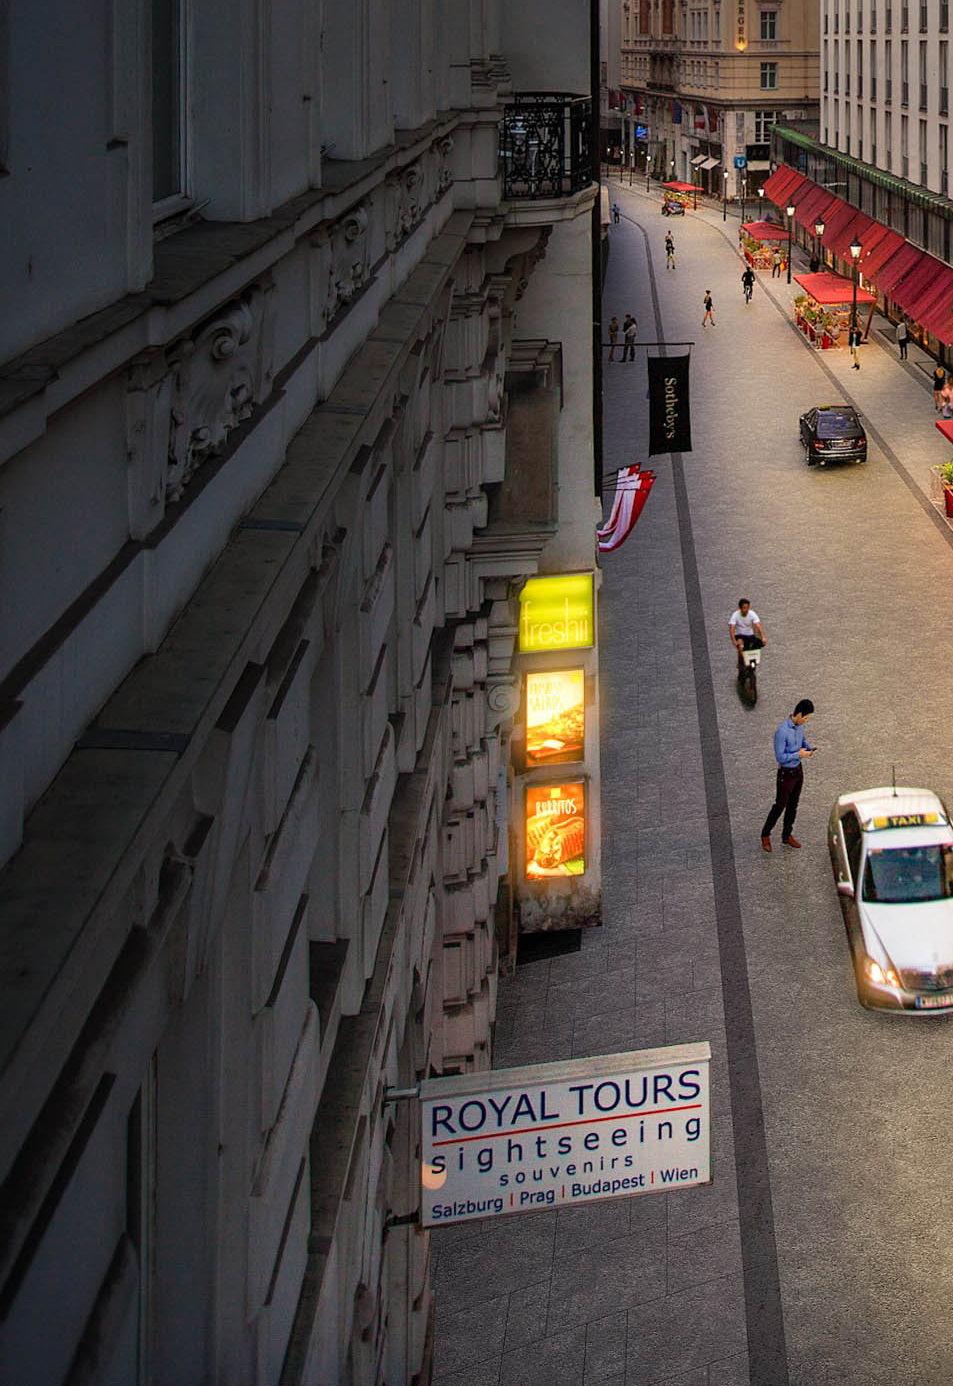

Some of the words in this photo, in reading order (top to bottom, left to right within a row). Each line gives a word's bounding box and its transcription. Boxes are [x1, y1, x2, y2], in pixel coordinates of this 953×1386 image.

[663, 377, 679, 439] Sotheby's
[522, 597, 589, 647] freshii
[891, 815, 921, 826] TAXI
[431, 1091, 560, 1137] ROYAL
[569, 1070, 701, 1115] TOURS
[431, 1117, 701, 1174] sightseeing
[499, 1154, 634, 1187] souvenirs
[431, 1196, 504, 1220] Salzburg
[519, 1188, 555, 1205] Prag
[572, 1174, 646, 1198] Budapest
[660, 1166, 699, 1183] Wien
